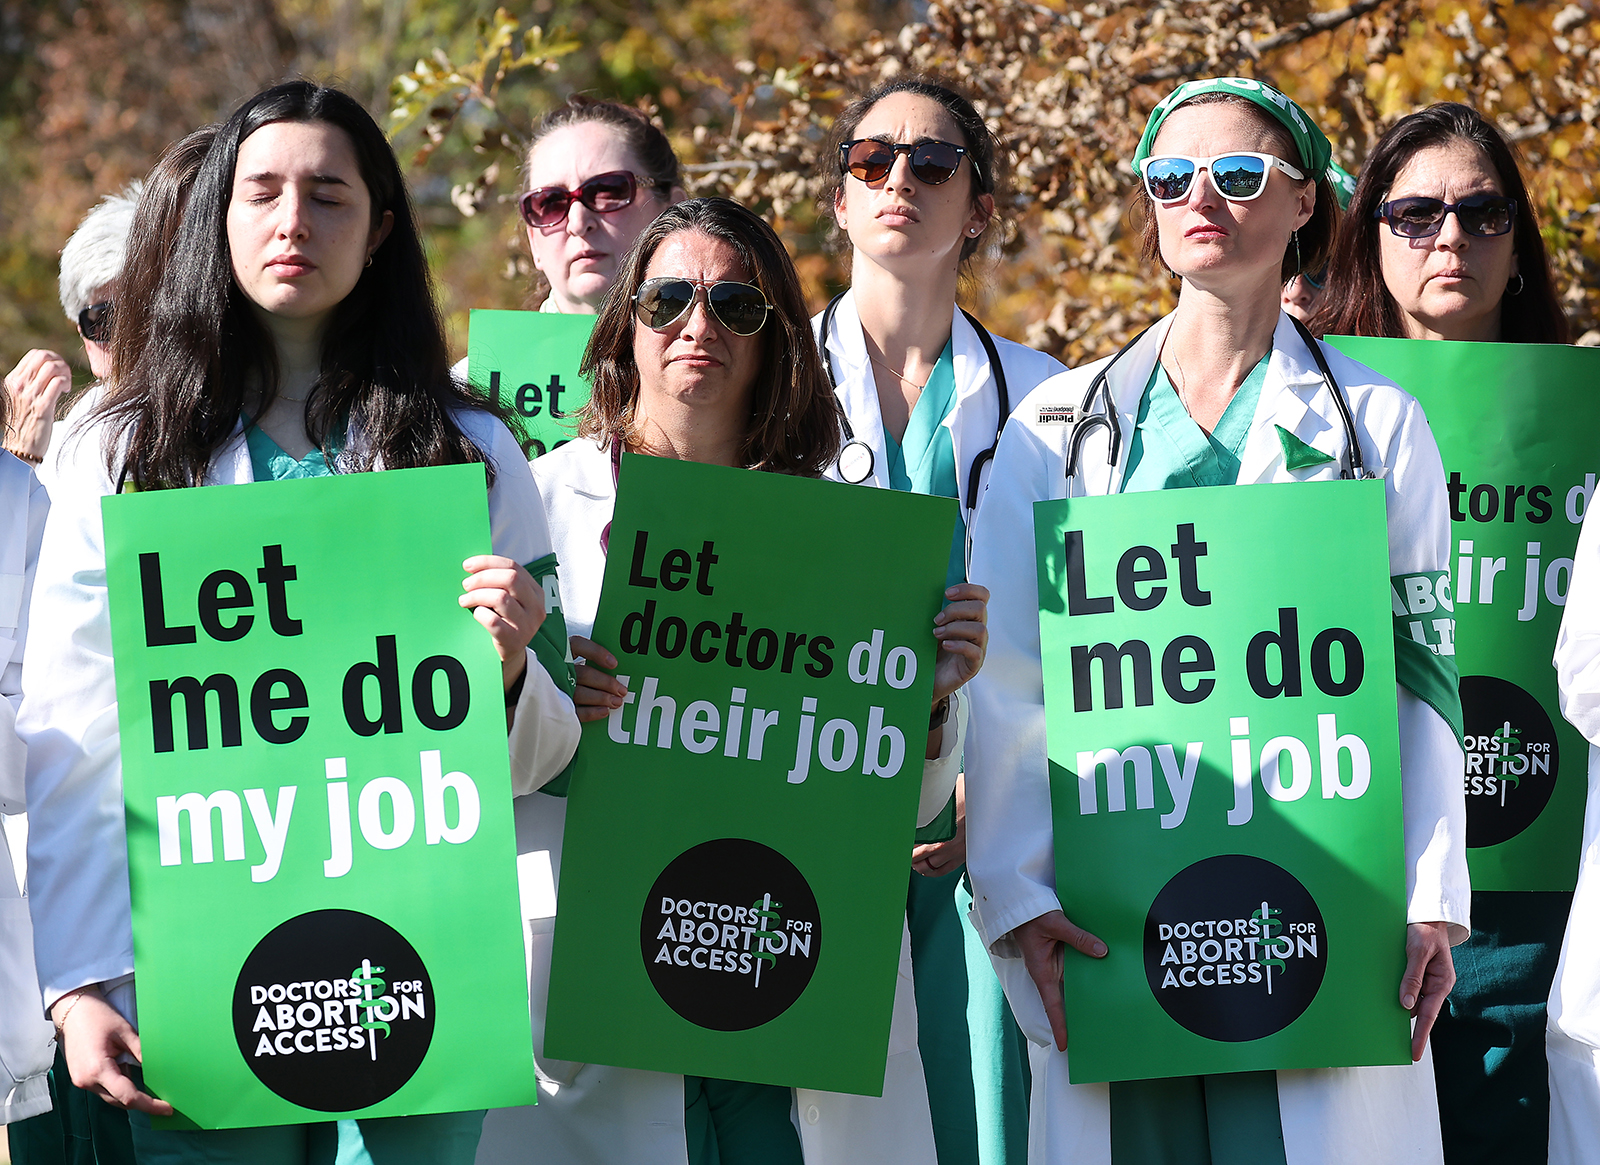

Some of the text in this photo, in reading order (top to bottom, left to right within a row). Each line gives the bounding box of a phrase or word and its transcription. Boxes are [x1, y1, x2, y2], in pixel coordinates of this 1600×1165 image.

[1038, 414, 1074, 423] Plendil
[628, 529, 720, 597] Let
[1064, 522, 1212, 617] Let
[138, 544, 303, 648] Let
[619, 599, 836, 679] doctors
[847, 628, 917, 690] do
[1070, 607, 1365, 713] me do
[149, 667, 310, 754] me
[342, 634, 471, 737] do
[606, 673, 906, 784] their job
[1526, 743, 1551, 753] FOR
[1076, 713, 1372, 830] my job
[156, 748, 481, 883] my job
[660, 896, 813, 933] DOCTORS FOR
[1158, 918, 1316, 941] DOCTORS FOR
[656, 916, 812, 959] ABORTION
[1160, 934, 1318, 966] ABORTION
[654, 942, 753, 975] ACCESS
[1161, 962, 1263, 989] ACCESS
[250, 977, 423, 1005] DOCTORS FOR
[252, 993, 426, 1033] ABORTION
[254, 1025, 366, 1058] ACCESS
